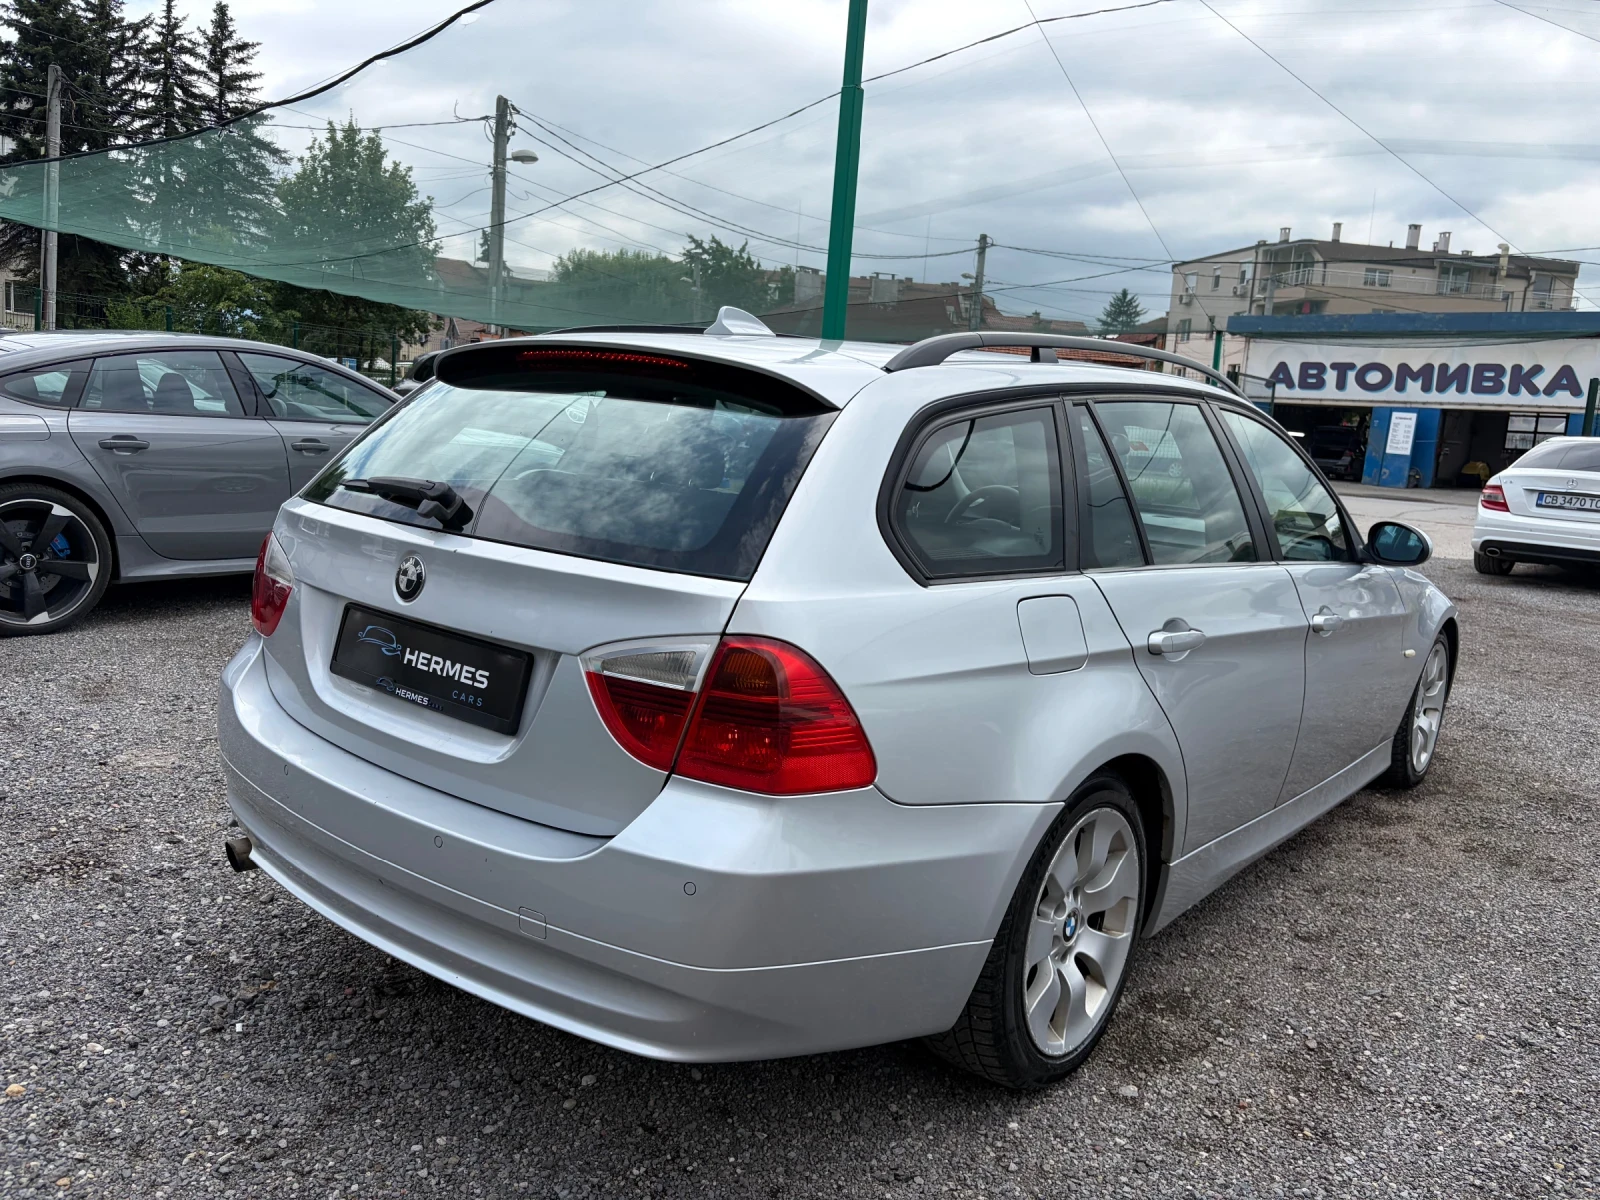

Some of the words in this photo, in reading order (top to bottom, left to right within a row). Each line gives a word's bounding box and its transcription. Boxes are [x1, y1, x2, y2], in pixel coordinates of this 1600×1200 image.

[1264, 361, 1584, 398] АВТОМИВКА
[1544, 495, 1559, 505] CB
[1560, 496, 1586, 508] 3470
[403, 647, 490, 689] HERMES
[395, 687, 429, 705] HERMES
[452, 690, 483, 707] CARS
